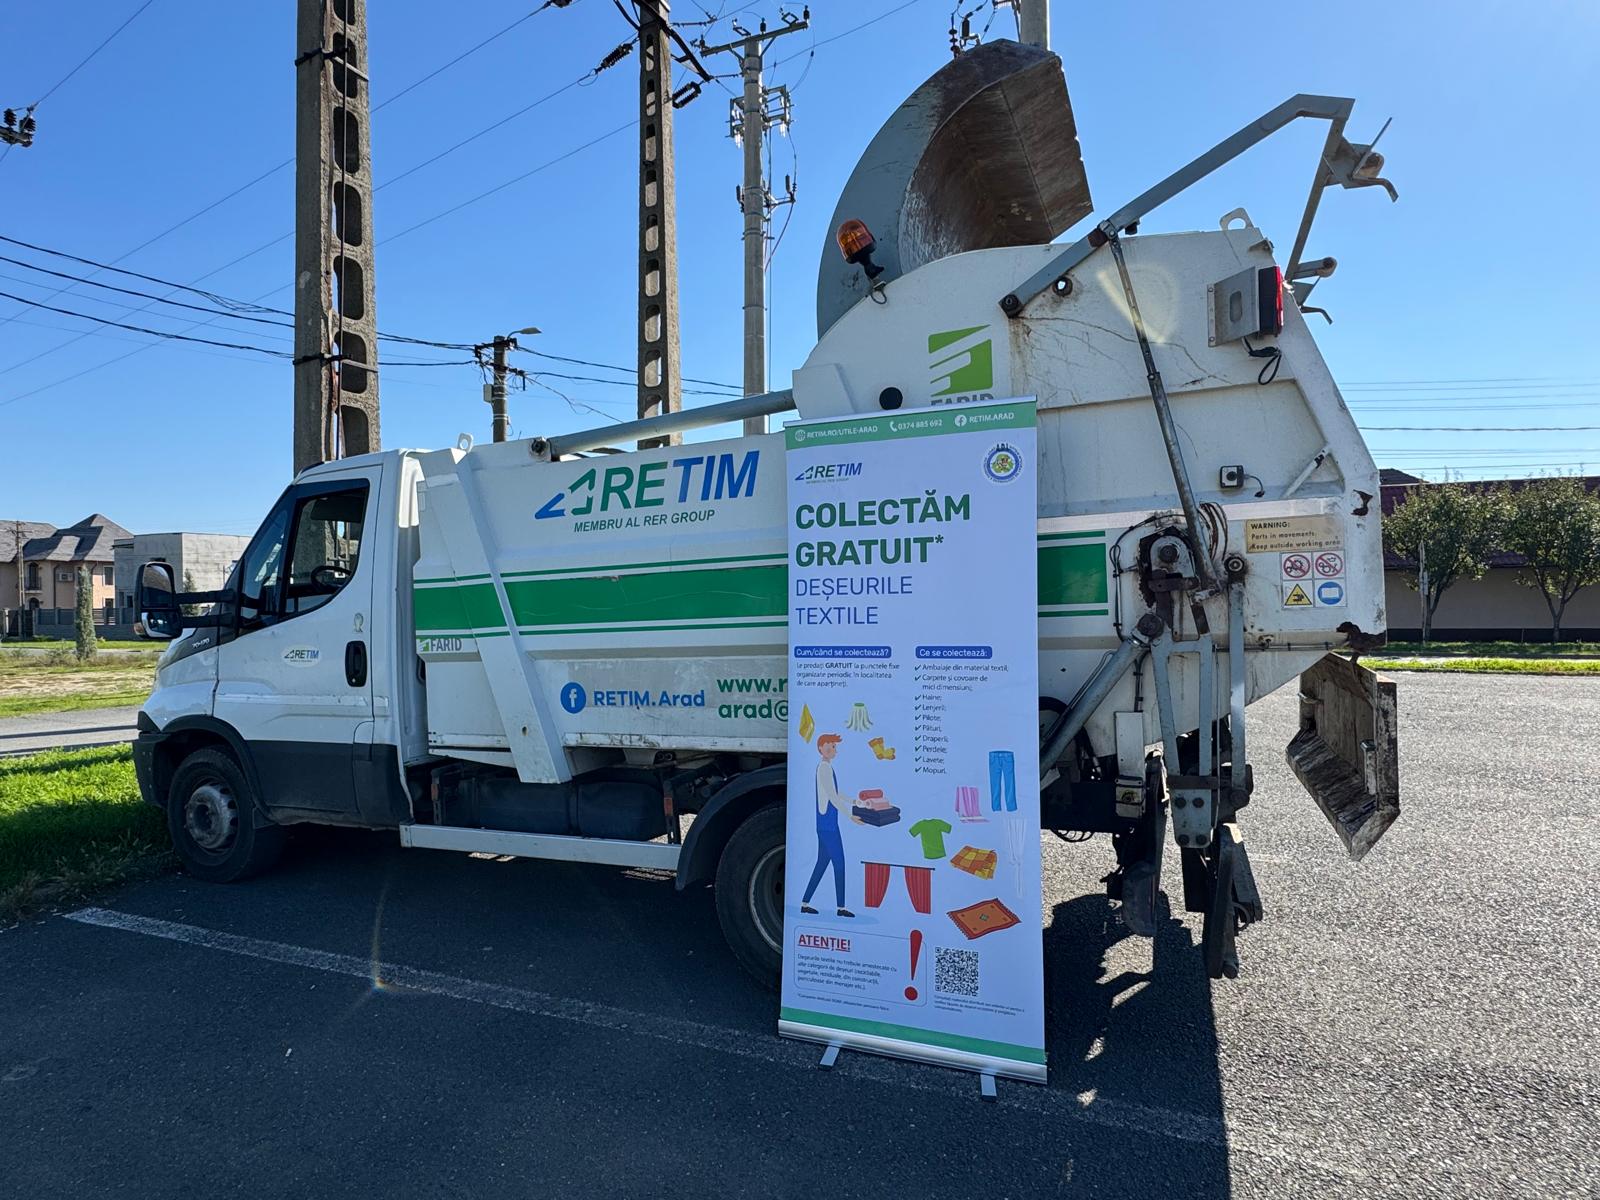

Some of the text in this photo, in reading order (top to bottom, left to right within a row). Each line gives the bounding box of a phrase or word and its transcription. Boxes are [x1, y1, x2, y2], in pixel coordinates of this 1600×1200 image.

[969, 412, 1014, 423] RETIM.ARAD
[898, 422, 914, 430] 0374
[814, 463, 862, 478] RETIM
[600, 450, 760, 512] RETIM
[796, 489, 970, 530] COLECTĂM
[574, 510, 715, 533] MEMBRU AL RER GROUP
[1251, 522, 1290, 530] WARNING:
[796, 576, 913, 601] DEȘEURILE
[796, 606, 878, 625] TEXTILE
[430, 638, 462, 652] FARID
[920, 648, 930, 656] Ce
[295, 650, 320, 659] RETIM
[717, 678, 788, 692] www.r
[922, 674, 946, 682] Carpete
[594, 690, 705, 708] RETIM.Arad
[798, 934, 851, 951] ATENȚIE!
